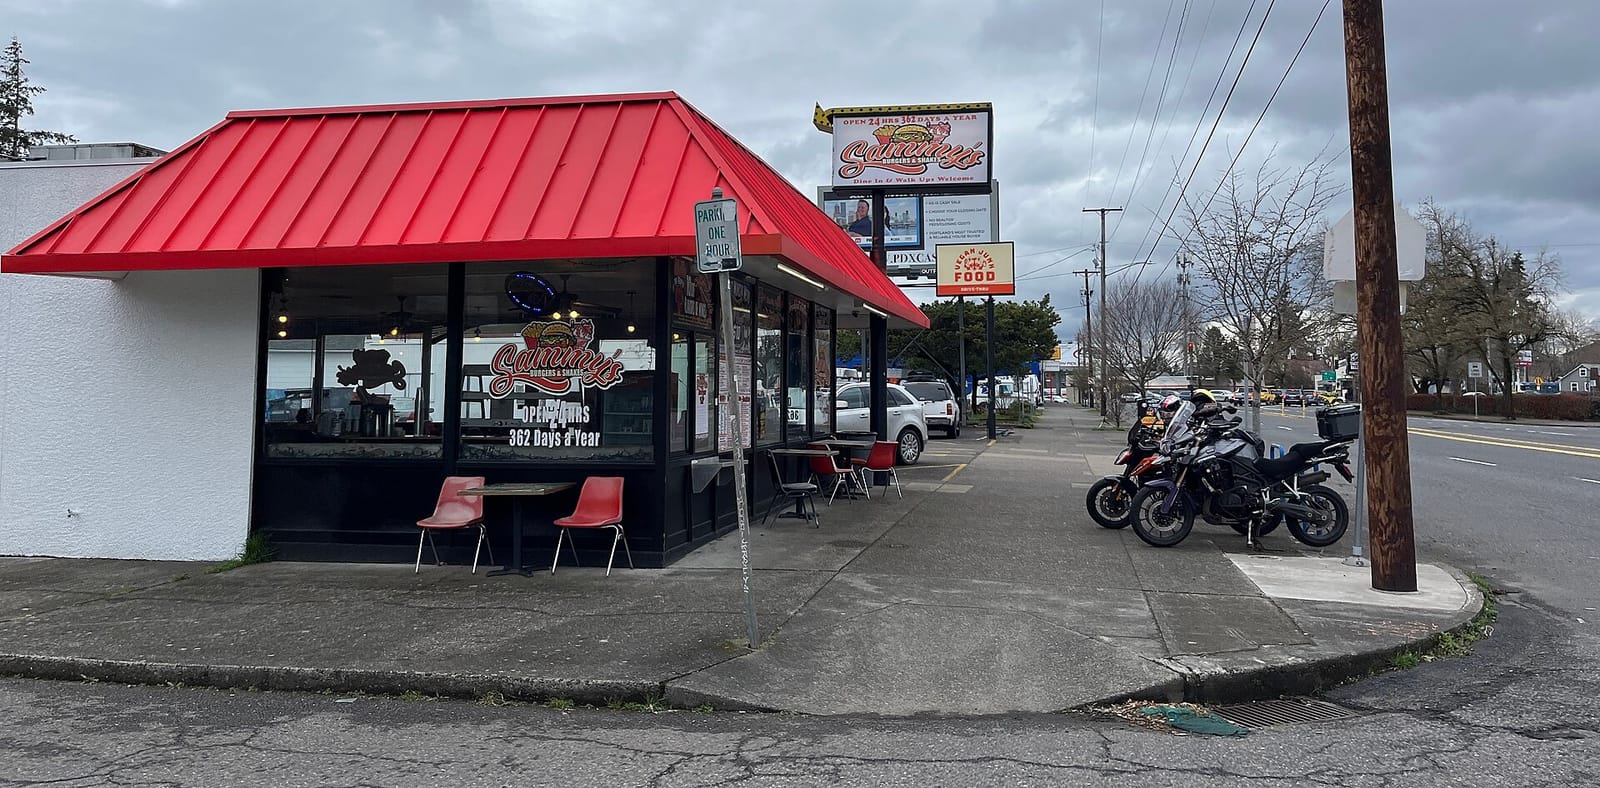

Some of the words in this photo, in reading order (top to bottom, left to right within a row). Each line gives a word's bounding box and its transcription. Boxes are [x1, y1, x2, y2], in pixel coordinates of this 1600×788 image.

[868, 118, 880, 126] 24
[901, 115, 916, 124] 362
[840, 140, 985, 178] Sammy's
[919, 176, 935, 184] Ups
[708, 226, 726, 239] ONE
[706, 243, 730, 257] HOUR
[954, 248, 976, 270] VEGAN
[978, 249, 995, 269] JUNK
[954, 271, 995, 282] FOOD
[490, 343, 623, 398] Sammy's
[529, 369, 556, 377] BURGERS
[556, 369, 561, 377] &
[561, 368, 584, 377] SHAKES
[522, 405, 549, 423] OPEN
[549, 400, 567, 428] 24
[567, 405, 590, 423] HRS
[509, 429, 531, 446] 362
[533, 428, 561, 448] Days
[564, 432, 571, 446] a
[574, 429, 600, 446] Year
